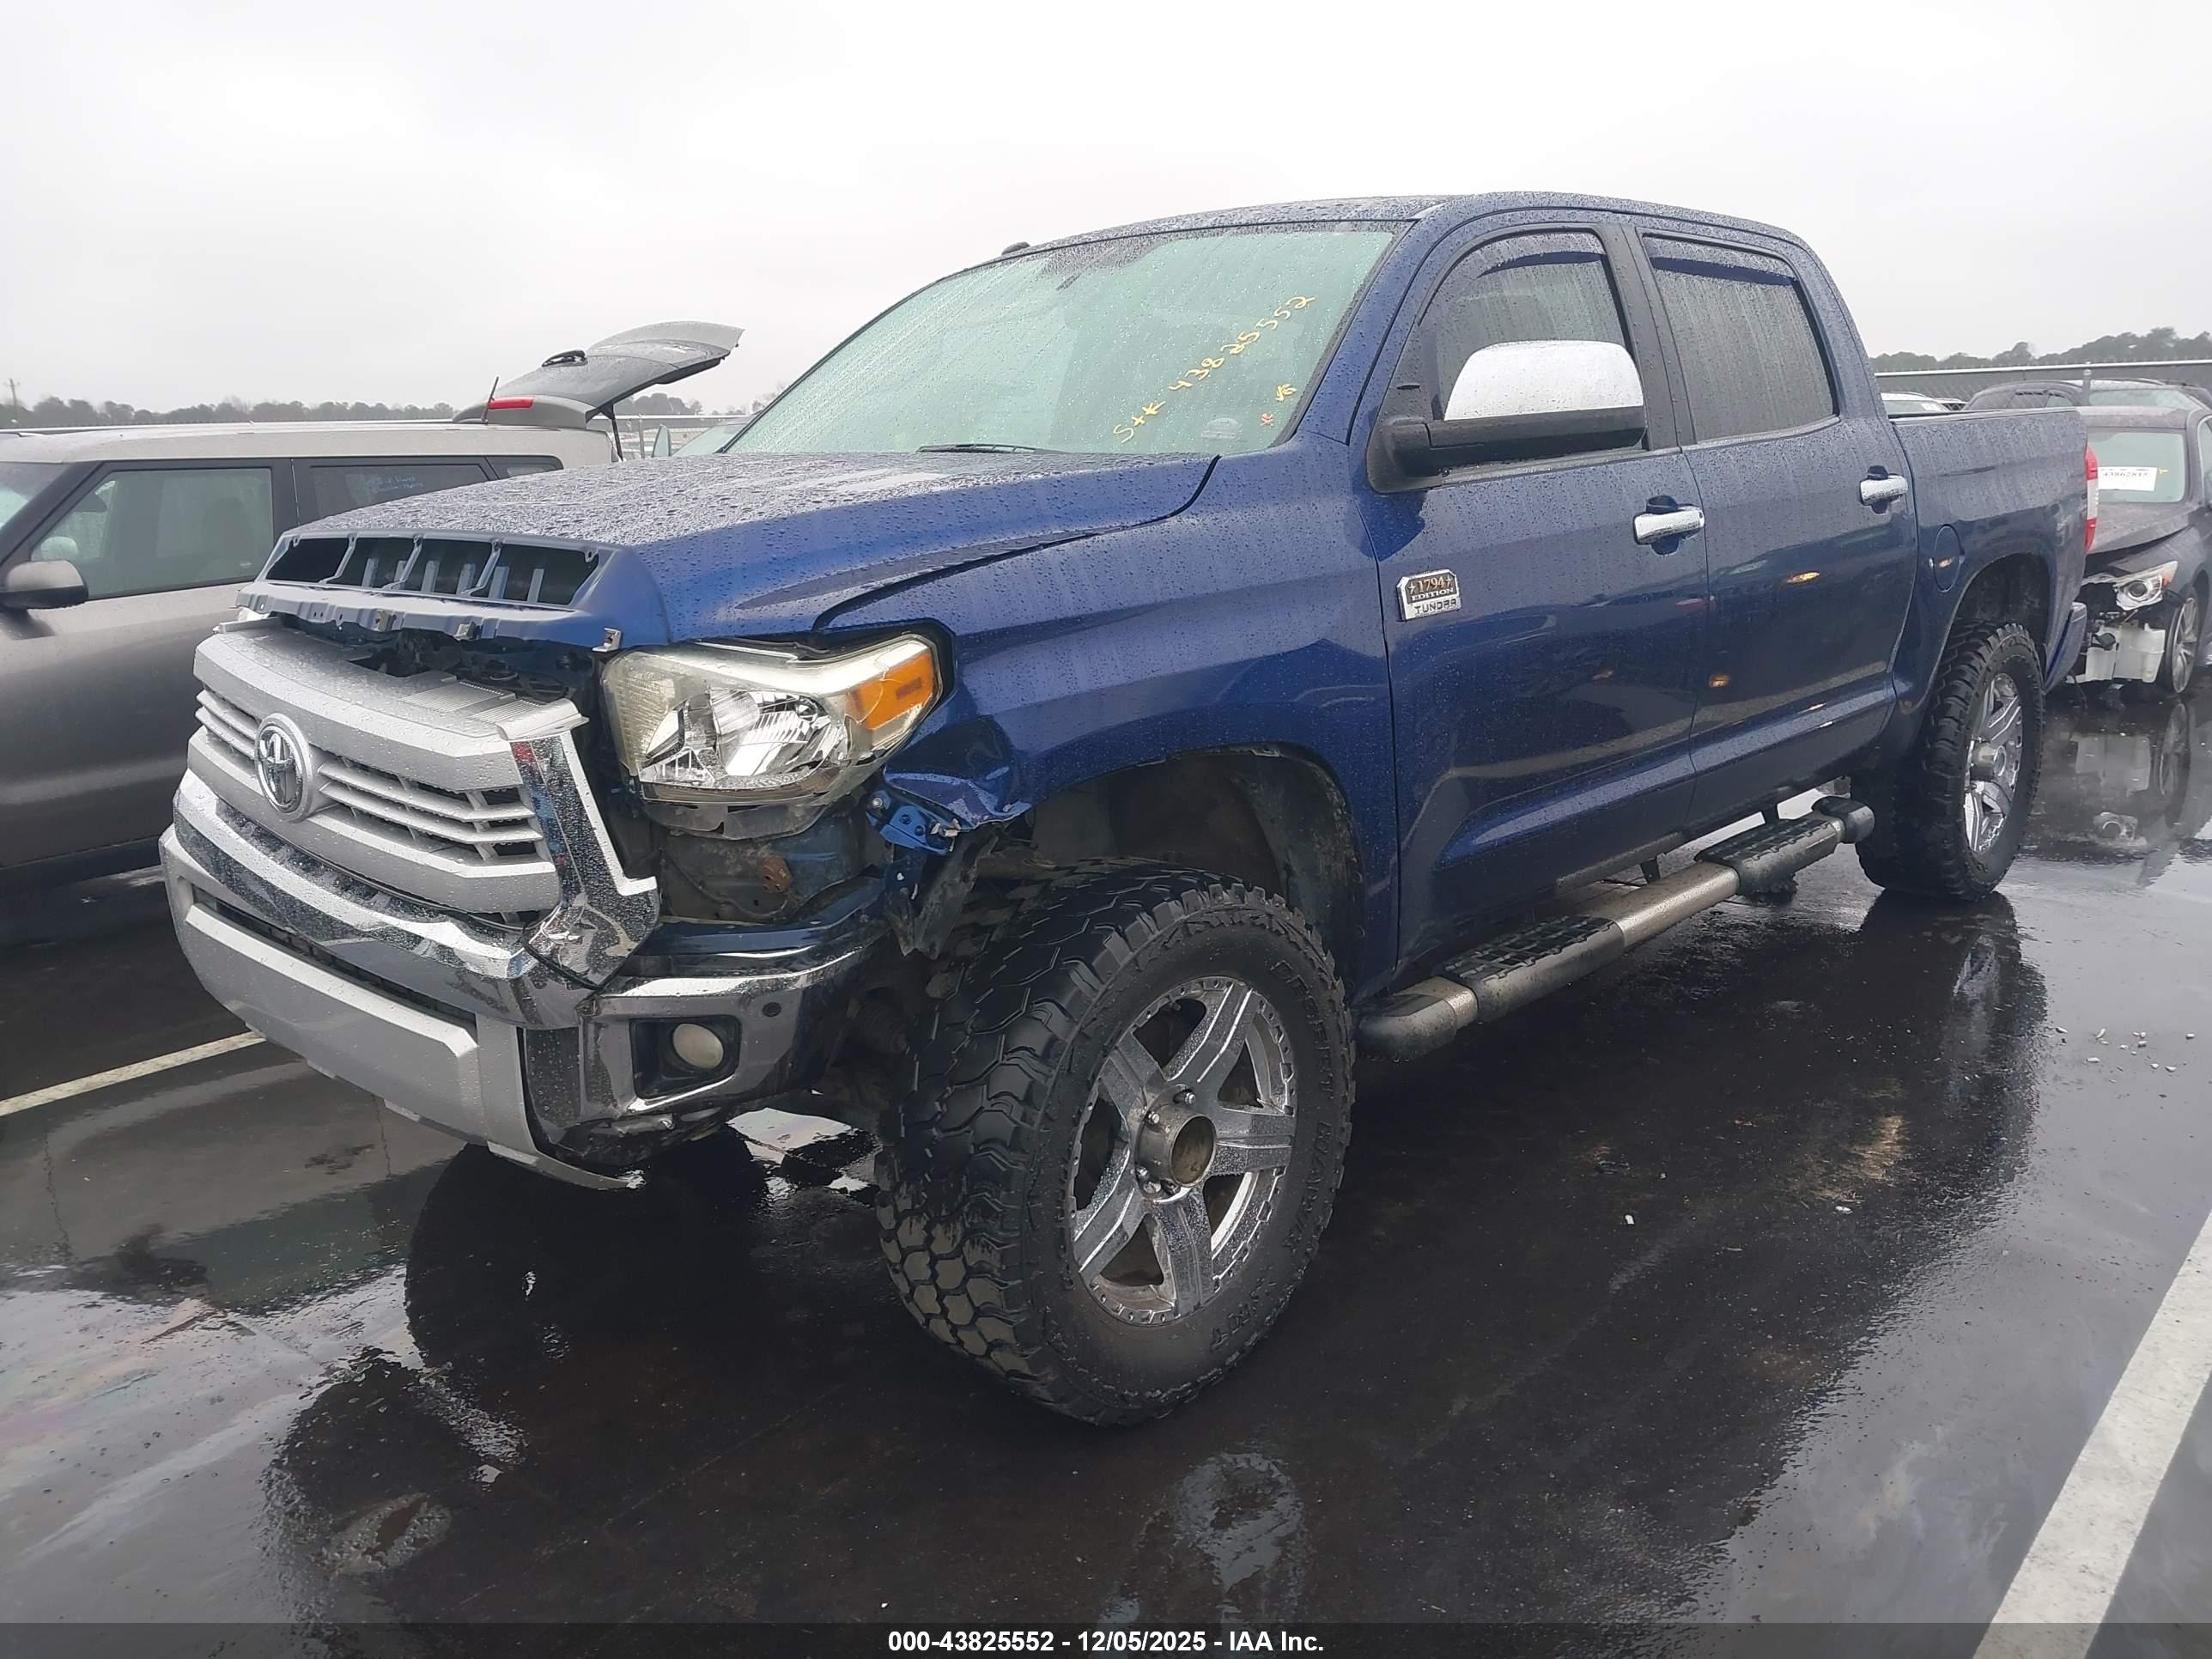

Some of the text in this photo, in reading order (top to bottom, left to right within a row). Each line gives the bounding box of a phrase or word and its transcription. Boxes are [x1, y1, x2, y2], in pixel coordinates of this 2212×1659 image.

[1169, 295, 1315, 391] 43825552
[1418, 577, 1445, 592] 1794
[1411, 587, 1454, 601] EDITION
[1415, 599, 1457, 615] TUNDRA
